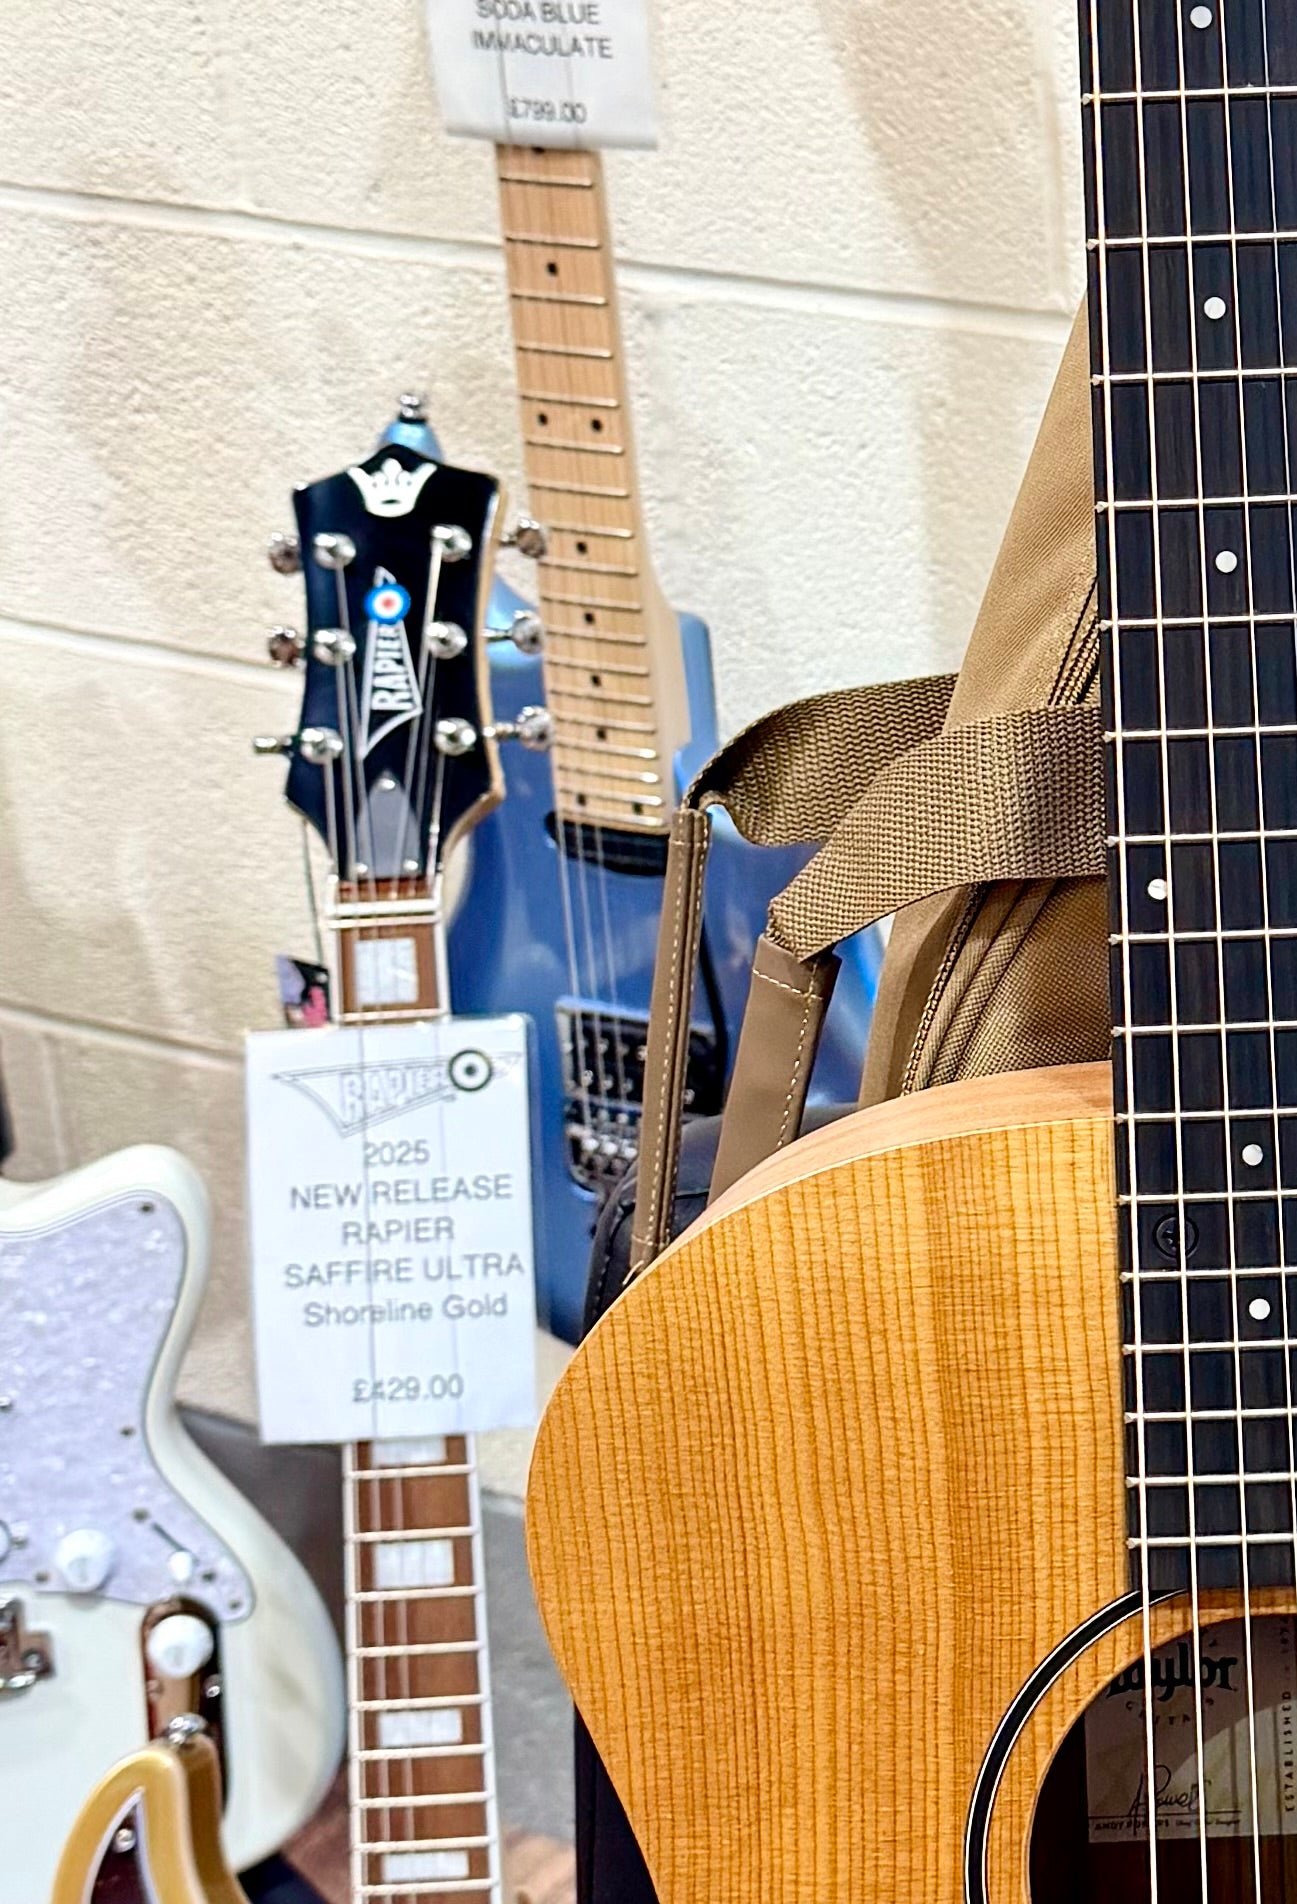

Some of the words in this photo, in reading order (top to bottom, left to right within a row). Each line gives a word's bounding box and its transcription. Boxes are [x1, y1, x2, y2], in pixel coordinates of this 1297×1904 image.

[542, 0, 601, 25] BLUE
[472, 32, 614, 59] IMMACULATE
[507, 97, 588, 124] £799.00
[339, 1065, 447, 1124] RAPIER
[363, 1139, 430, 1167] 2025
[290, 1182, 362, 1210] NEW
[373, 1174, 513, 1205] RELEASE
[342, 1217, 455, 1246] RAPIER
[284, 1260, 413, 1289] SAFFIRE
[423, 1252, 526, 1281] ULTRA
[303, 1298, 433, 1328] Shoreline
[442, 1291, 509, 1320] Gold
[352, 1372, 465, 1404] £429.00
